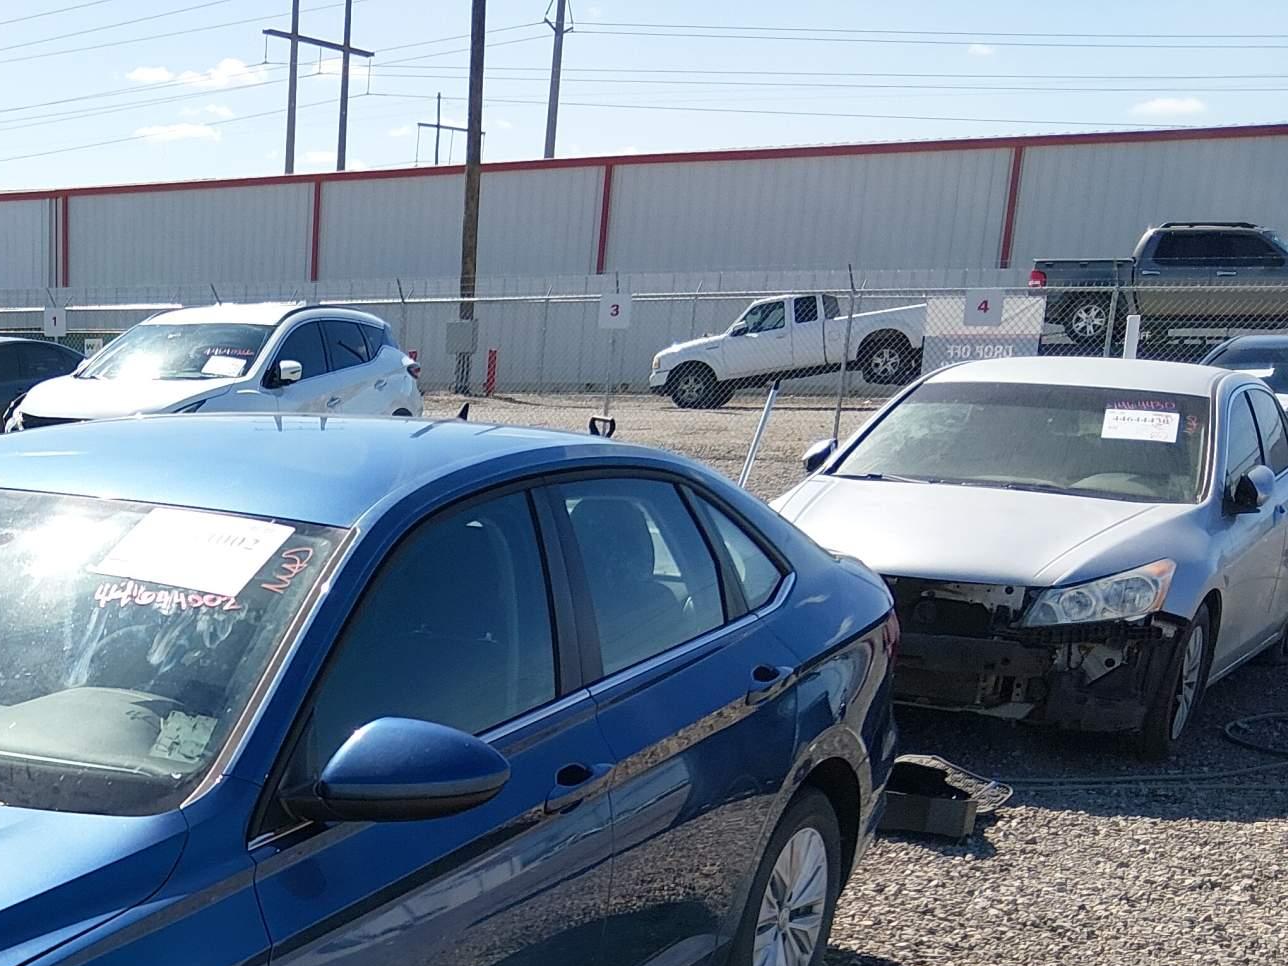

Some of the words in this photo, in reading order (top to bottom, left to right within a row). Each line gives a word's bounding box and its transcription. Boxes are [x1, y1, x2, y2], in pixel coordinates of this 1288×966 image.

[610, 303, 620, 317] 3
[977, 299, 990, 314] 4
[52, 315, 57, 327] 1
